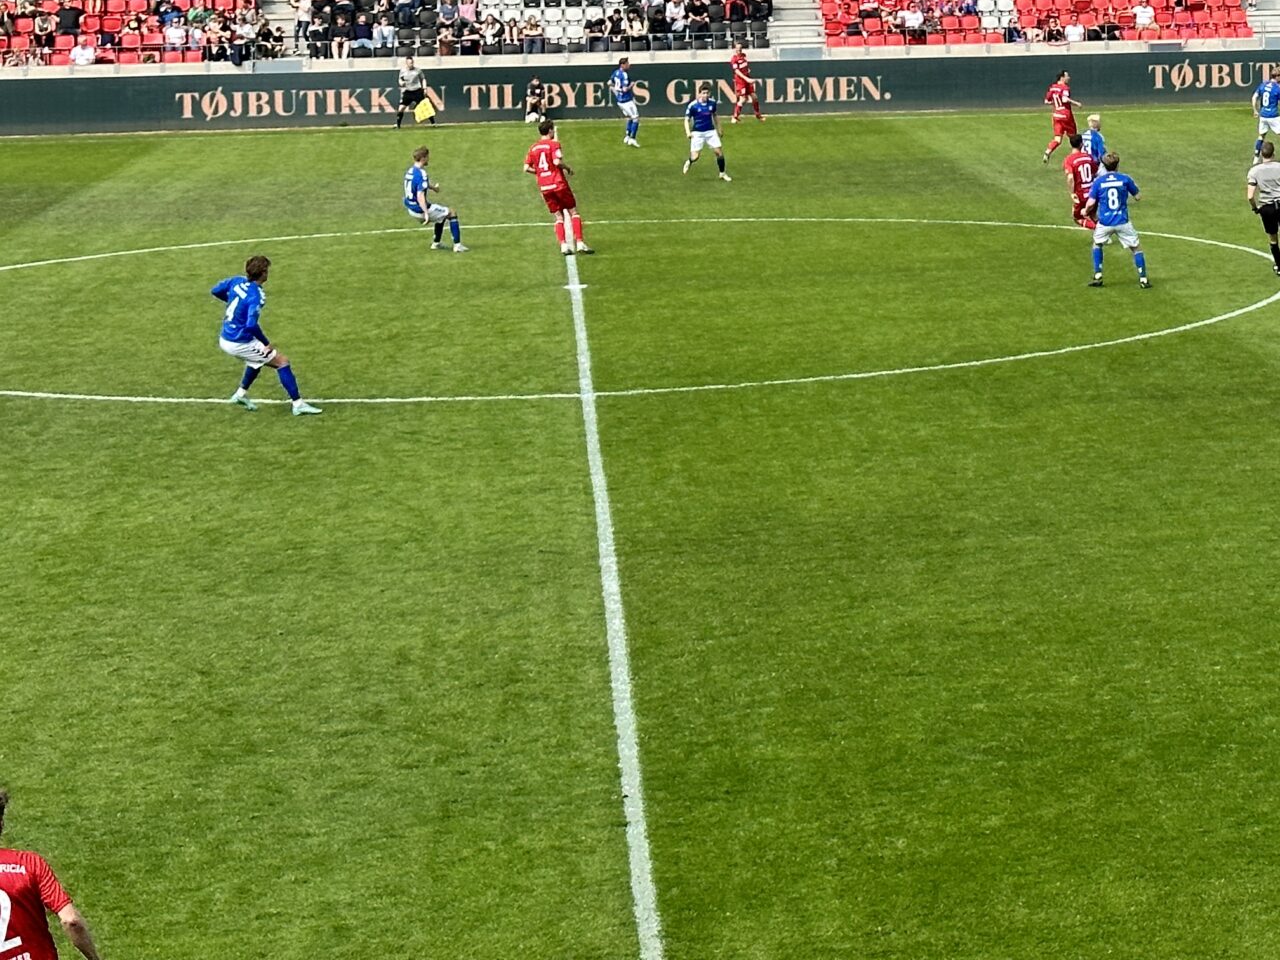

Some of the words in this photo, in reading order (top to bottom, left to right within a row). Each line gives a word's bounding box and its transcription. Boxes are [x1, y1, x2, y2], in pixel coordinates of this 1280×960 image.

[175, 86, 446, 121] TØJBUTIKKN
[463, 83, 523, 111] TIL
[543, 80, 651, 110] BYES
[666, 75, 892, 105] GENLEMEN.
[538, 151, 549, 171] 4
[1078, 163, 1092, 183] 10
[1107, 187, 1119, 210] 8
